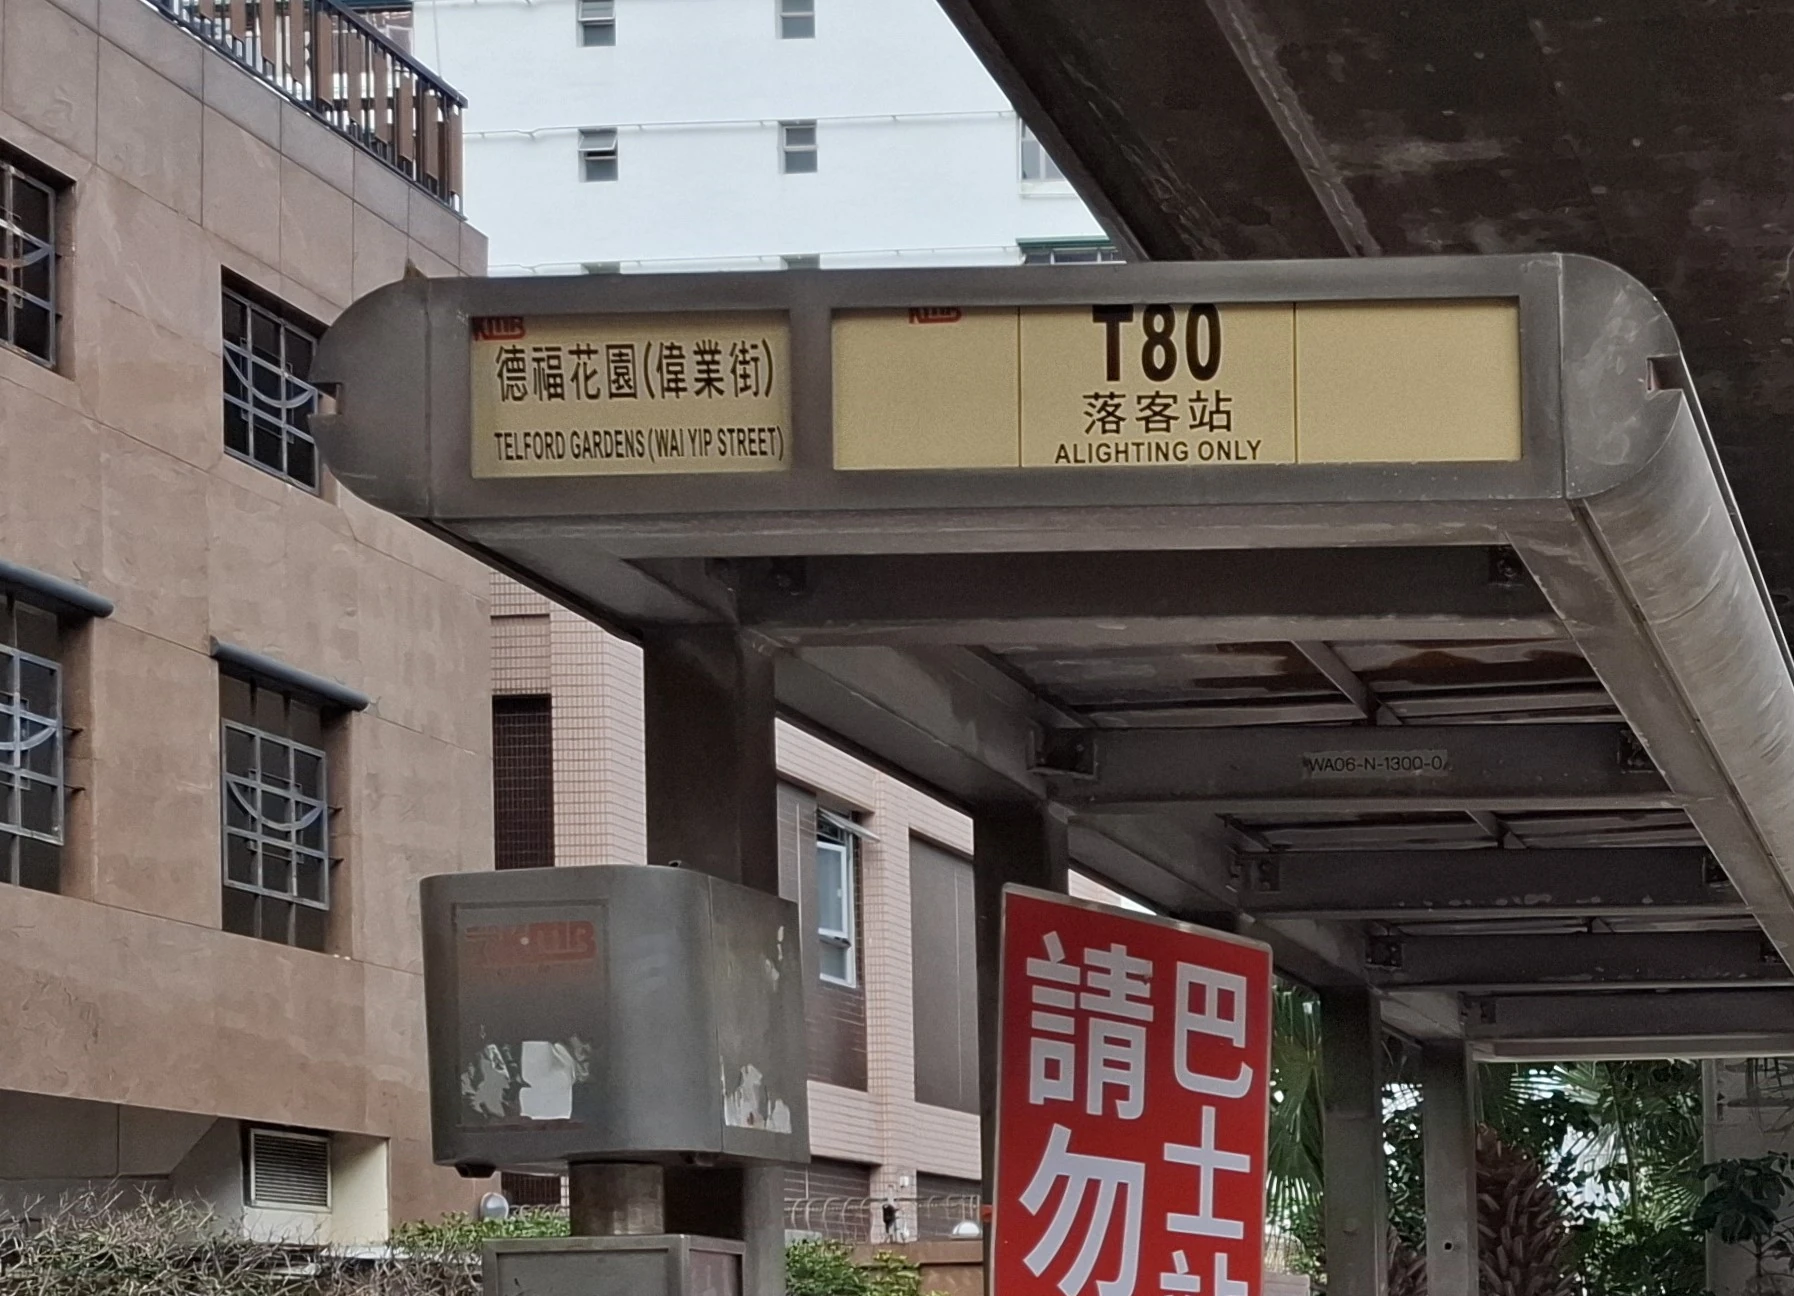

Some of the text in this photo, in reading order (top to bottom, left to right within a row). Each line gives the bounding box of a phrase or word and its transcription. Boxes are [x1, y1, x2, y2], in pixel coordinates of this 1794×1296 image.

[471, 316, 526, 341] KMB
[1092, 303, 1222, 382] T80
[494, 338, 774, 403] 德福花園(偉業街)
[1082, 389, 1234, 436] 落客站
[494, 431, 566, 461] TELFORD
[570, 429, 645, 460] GARDENS
[687, 427, 712, 458] YIP
[717, 425, 785, 461] STREET)
[1055, 439, 1263, 464] ALIGHTING ONLY
